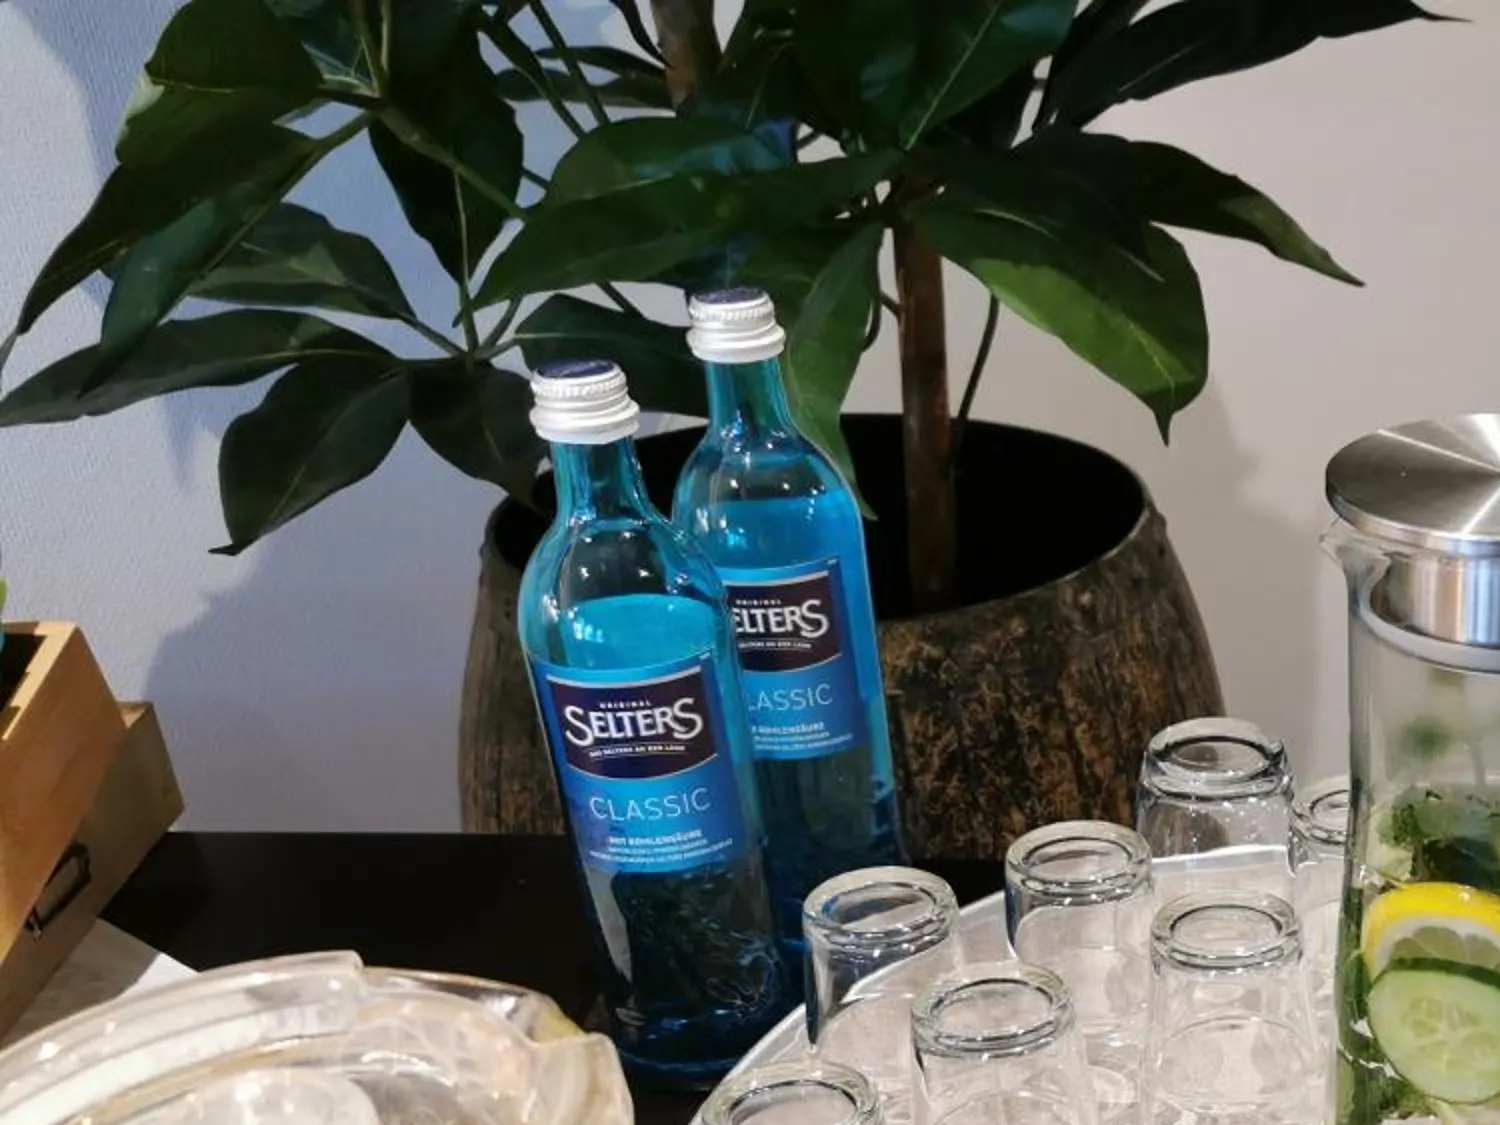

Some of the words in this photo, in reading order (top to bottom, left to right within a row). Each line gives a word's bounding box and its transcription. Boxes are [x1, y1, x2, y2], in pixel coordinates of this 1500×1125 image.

[731, 599, 830, 638] ELTERS
[564, 697, 704, 747] SELTERS
[589, 787, 711, 821] CLASSIC
